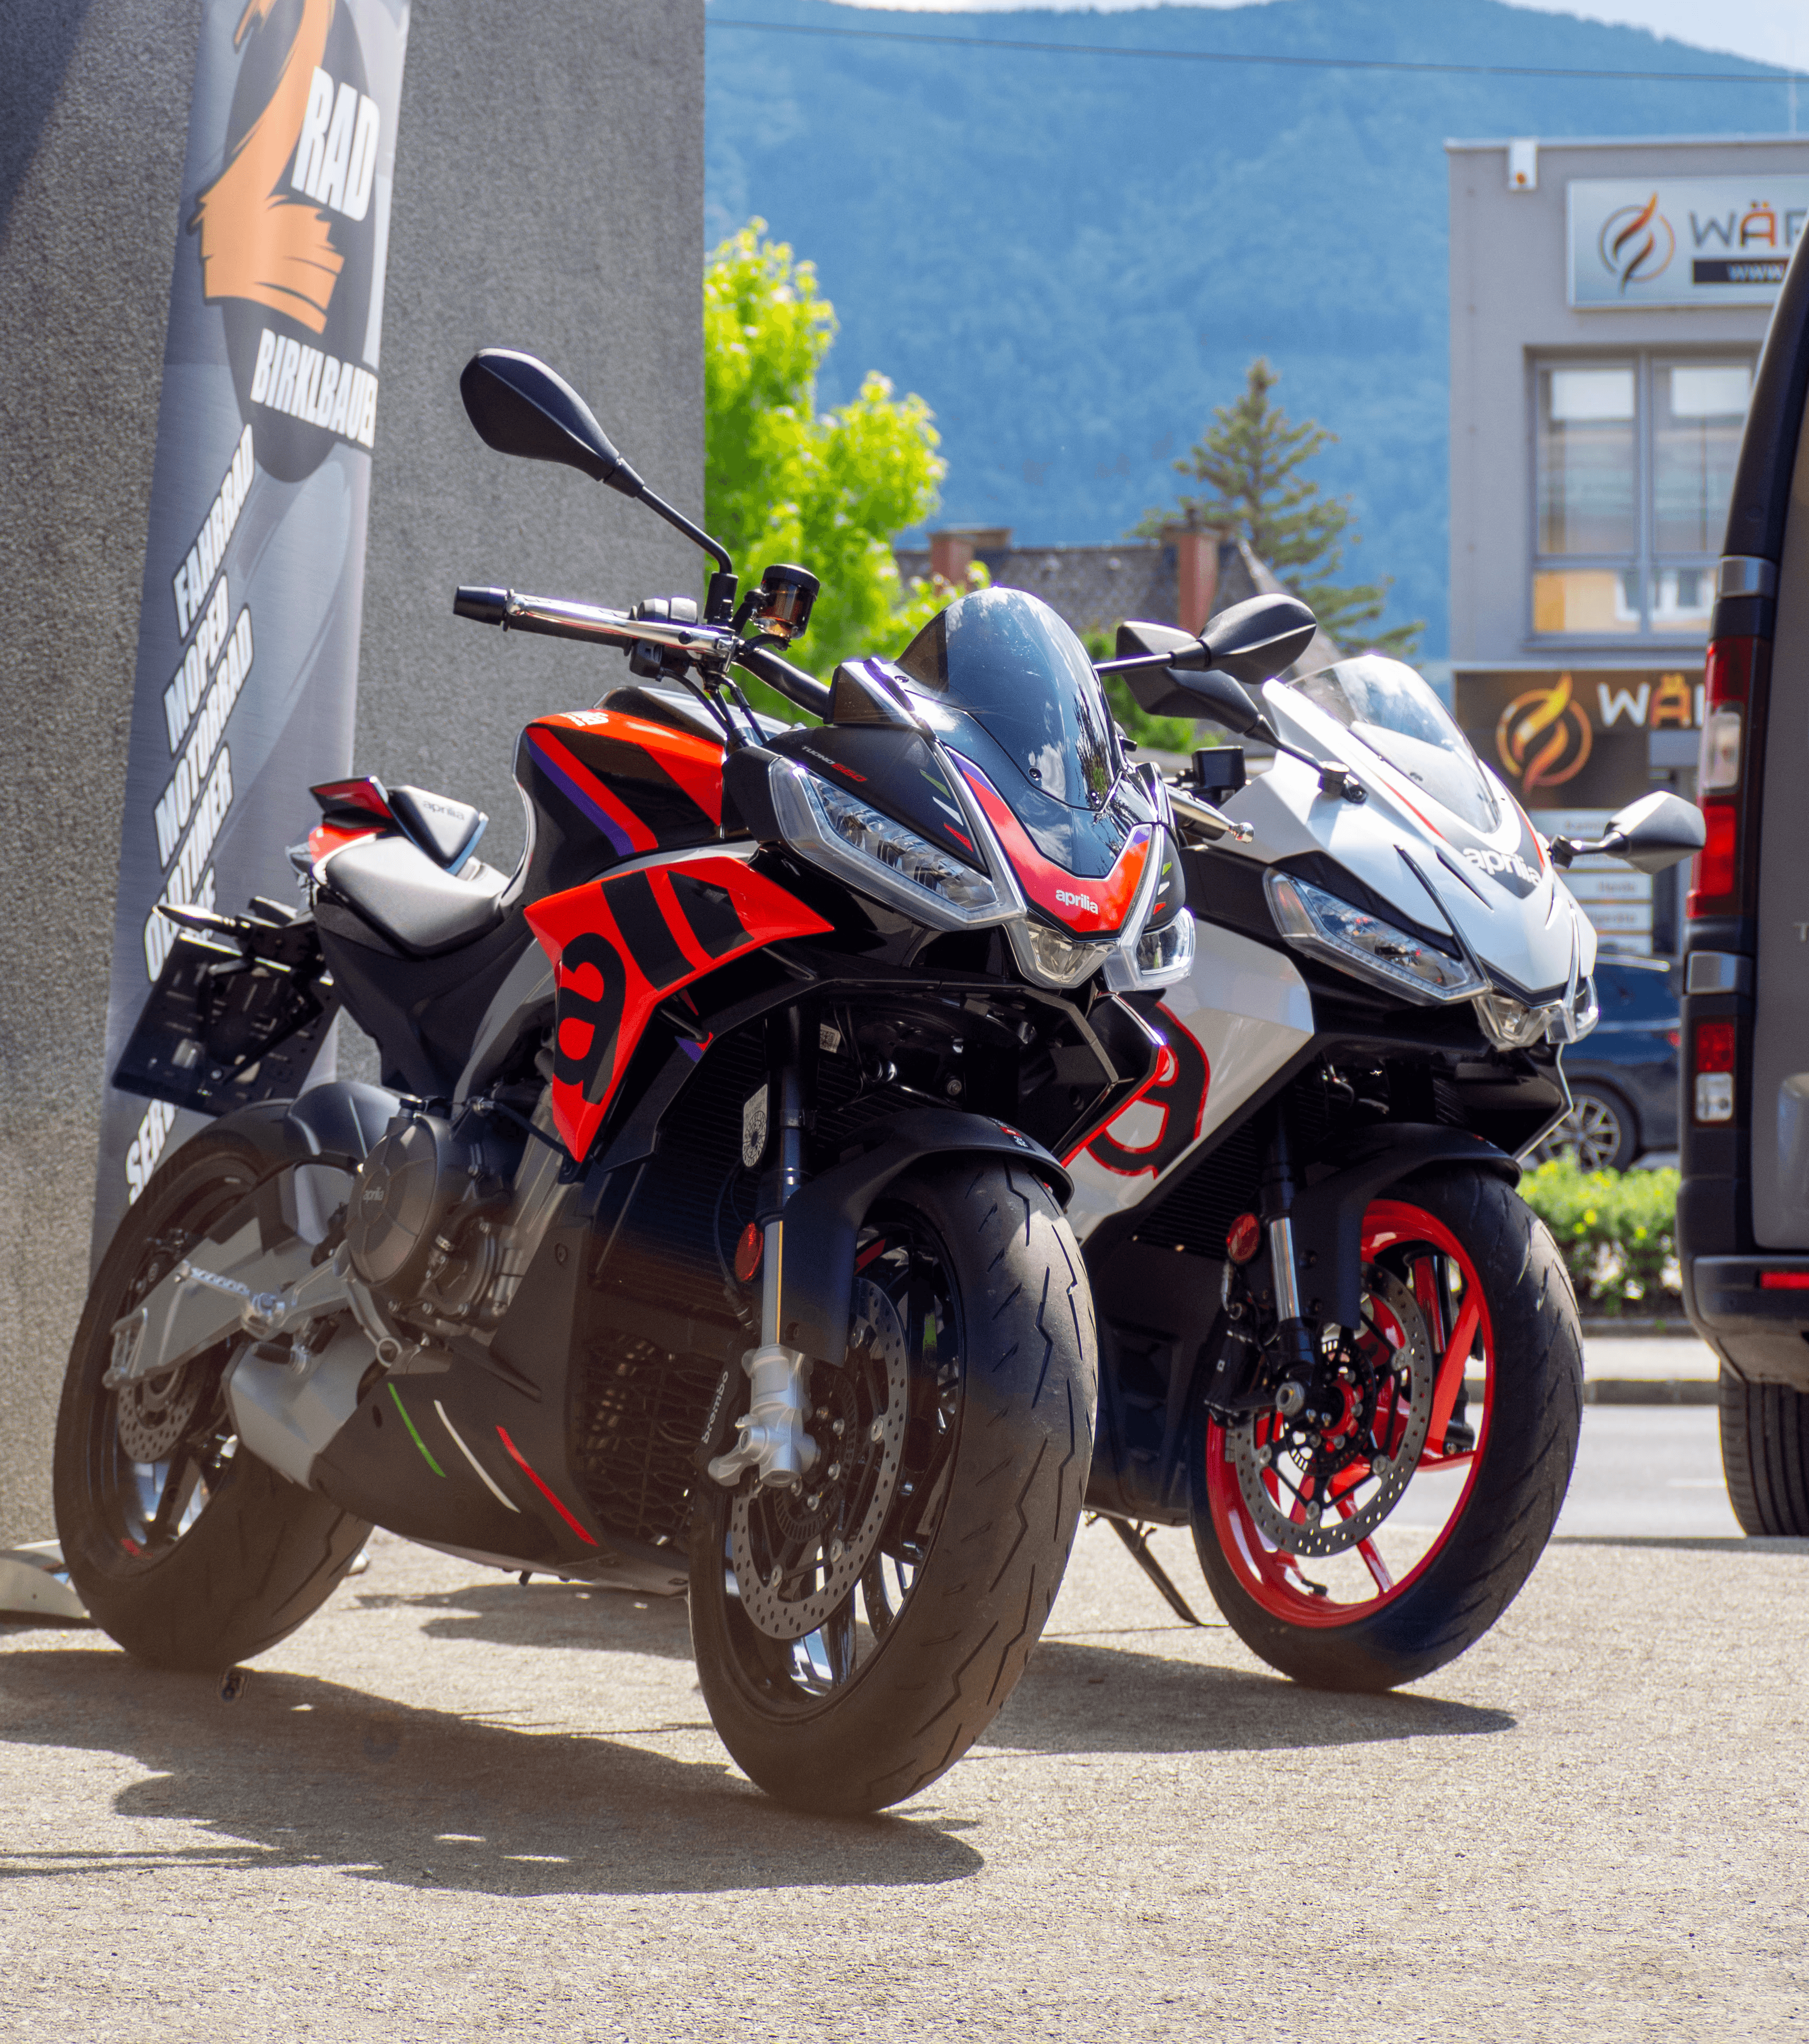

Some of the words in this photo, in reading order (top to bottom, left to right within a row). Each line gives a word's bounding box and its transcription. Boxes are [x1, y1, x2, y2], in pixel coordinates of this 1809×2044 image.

[291, 65, 380, 222] RAD
[173, 424, 254, 638] FAHRRAD
[164, 575, 229, 754] MOPED
[155, 608, 253, 868] MOTORRAD
[802, 746, 835, 764] TUONO
[831, 763, 867, 782] 660
[423, 799, 465, 821] aprilia
[1055, 888, 1099, 915] aprilia
[1462, 847, 1543, 887] aprilia
[701, 1371, 729, 1444] brembo
